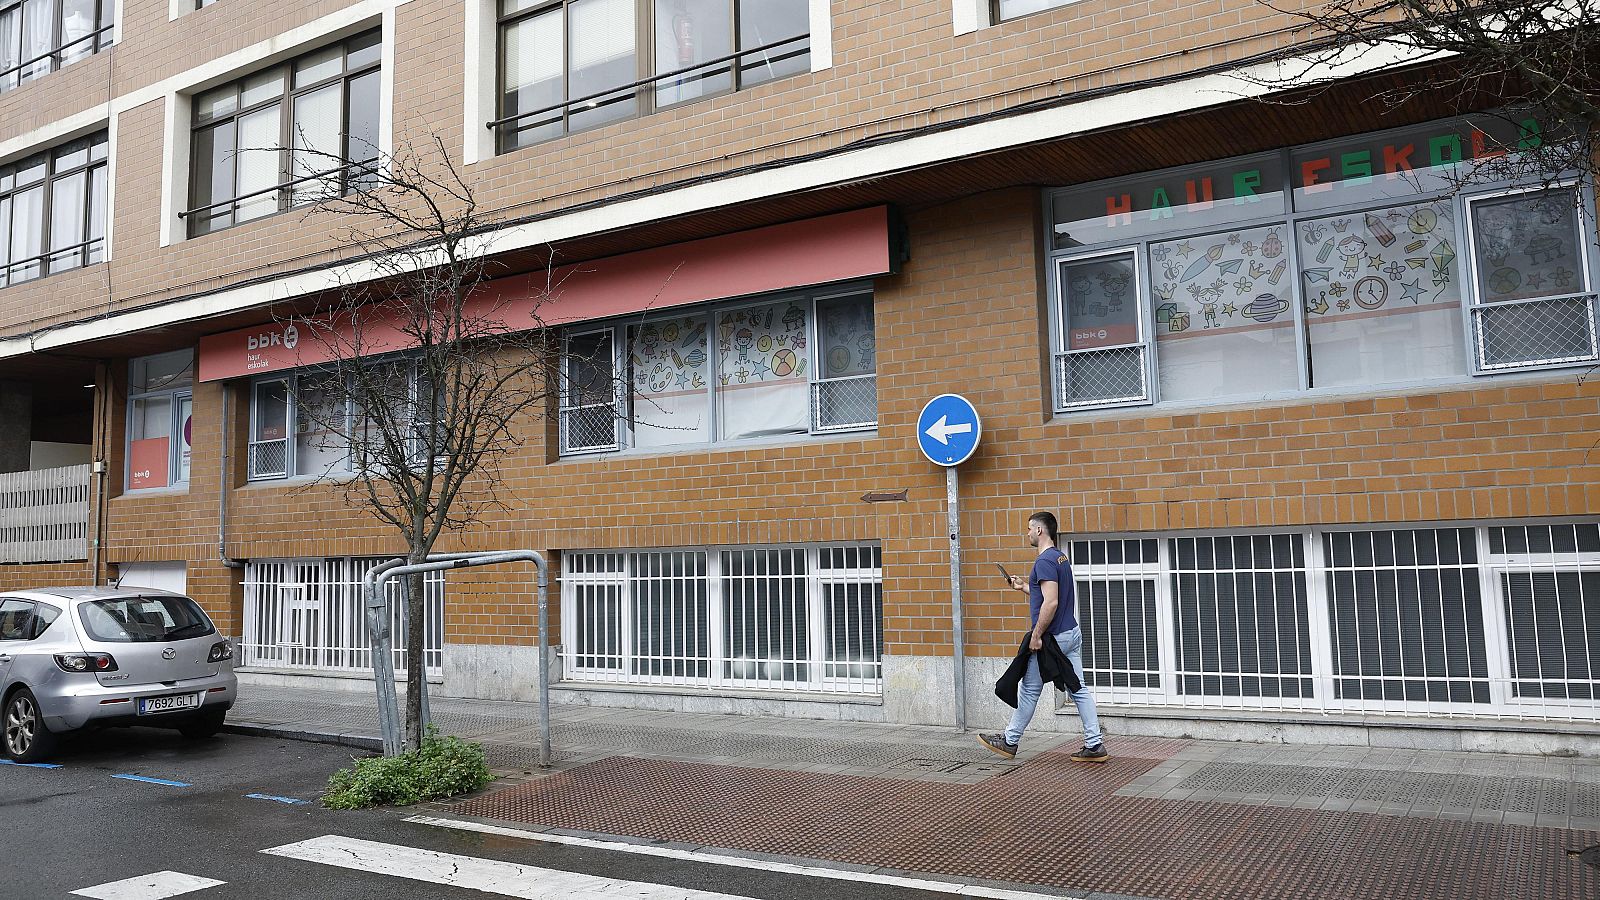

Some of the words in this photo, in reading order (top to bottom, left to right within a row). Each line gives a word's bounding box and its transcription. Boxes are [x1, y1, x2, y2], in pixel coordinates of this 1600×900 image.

[1106, 170, 1261, 228] HAUR
[1302, 118, 1547, 195] ESKOLA
[247, 331, 281, 350] bbk
[1075, 331, 1097, 340] bbk
[247, 353, 261, 361] haur
[148, 697, 174, 711] 7692
[176, 695, 194, 707] GLT
